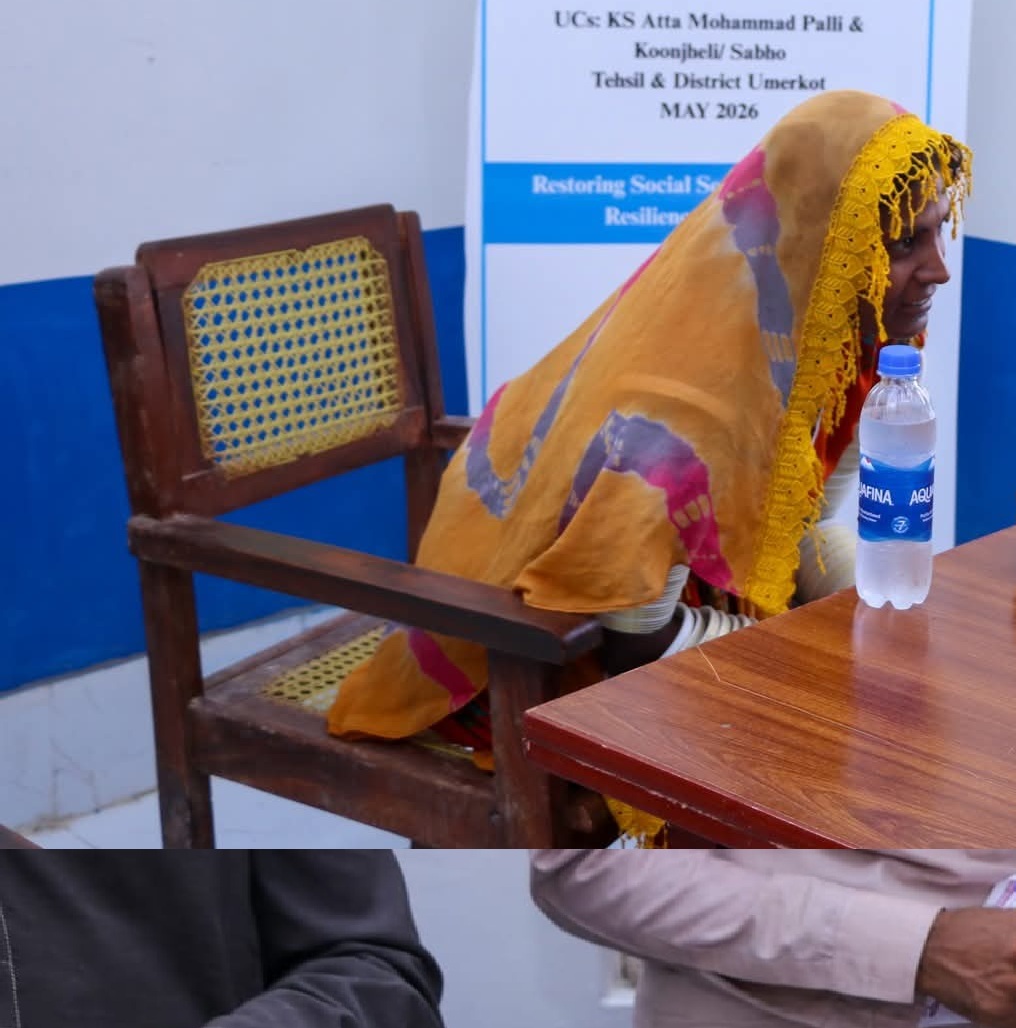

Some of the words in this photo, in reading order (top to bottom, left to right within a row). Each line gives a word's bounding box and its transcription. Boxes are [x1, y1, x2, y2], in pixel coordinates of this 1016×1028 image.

[554, 12, 600, 28] UCs:
[607, 13, 636, 29] KS
[642, 14, 681, 29] Atta
[688, 14, 796, 32] Mohammad
[802, 15, 843, 33] Palli
[849, 16, 863, 33] &
[634, 42, 724, 63] Koonjheli/
[730, 44, 786, 60] Sabho
[592, 72, 645, 89] Tehsil
[651, 73, 666, 89] &
[674, 73, 741, 90] District
[748, 74, 826, 91] Umerkot
[660, 103, 709, 119] MAY
[716, 103, 759, 119] 2026
[532, 175, 625, 199] Restoring
[630, 175, 690, 194] Social
[859, 482, 894, 506] AFINA
